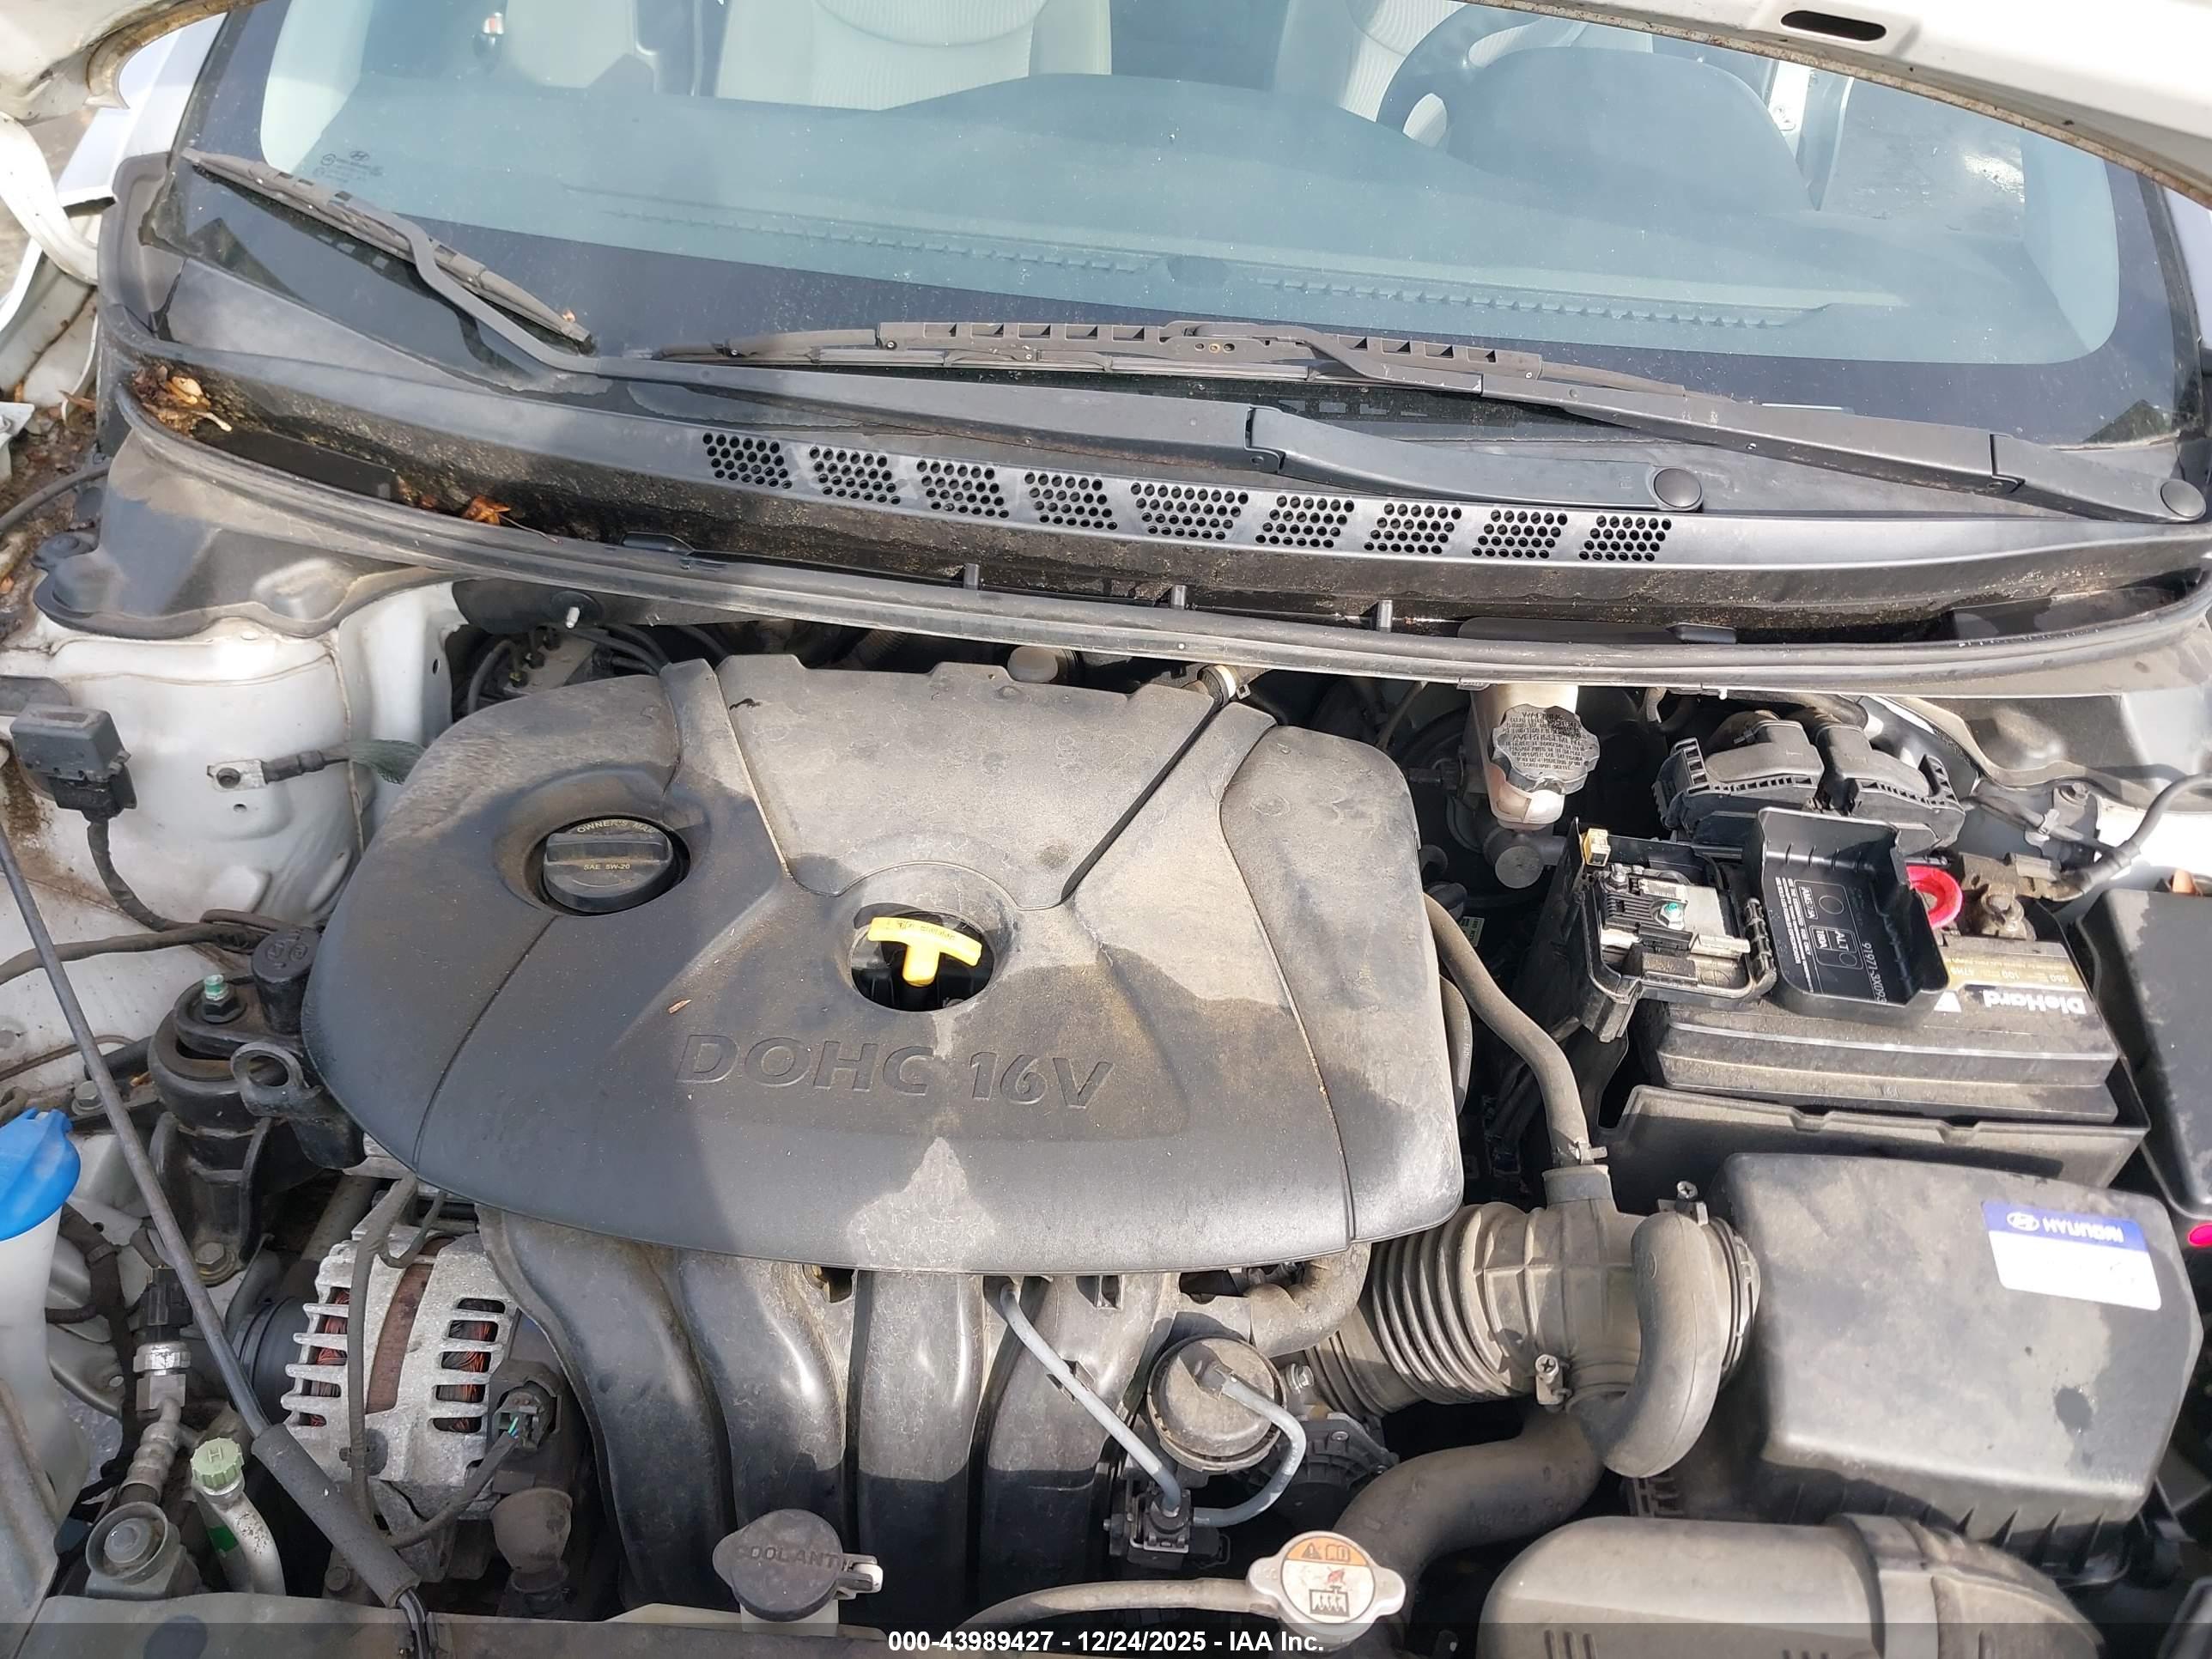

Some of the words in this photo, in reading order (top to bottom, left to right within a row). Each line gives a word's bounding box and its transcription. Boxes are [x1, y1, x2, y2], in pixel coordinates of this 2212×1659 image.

[577, 819, 629, 833] OWNER'S
[1801, 886, 1812, 905] AMS
[1815, 928, 1828, 949] 180A
[1834, 930, 1850, 951] ALT
[1862, 942, 1887, 1004] 91971-3X093
[1982, 989, 2087, 1015] DieHard
[676, 1034, 936, 1097] DOHC
[969, 1051, 1115, 1109] 16V
[2042, 1216, 2124, 1243] HYUNDAI
